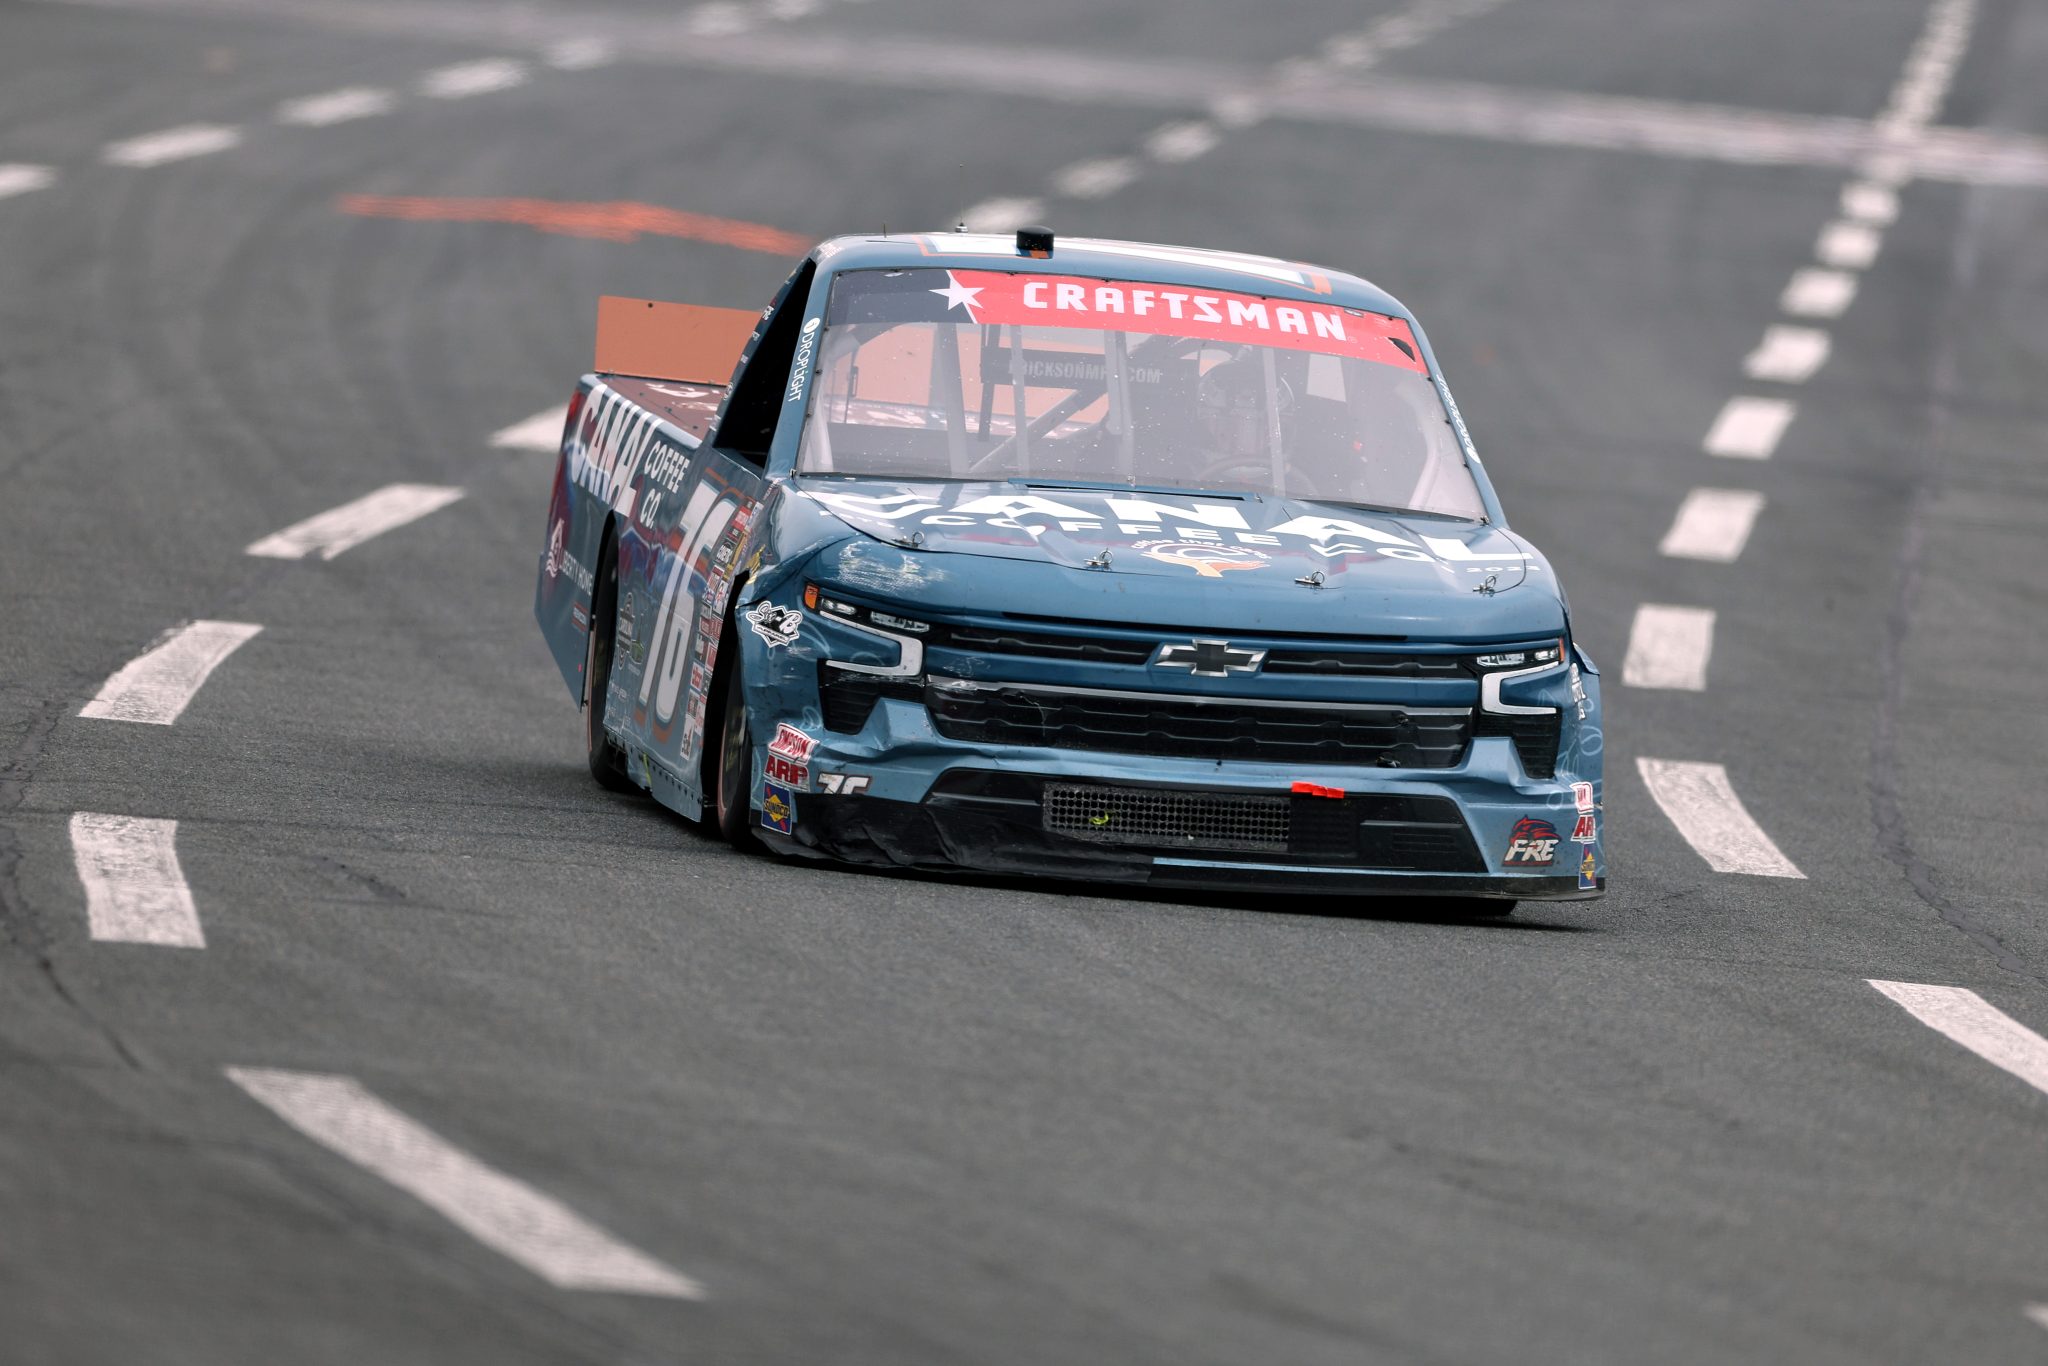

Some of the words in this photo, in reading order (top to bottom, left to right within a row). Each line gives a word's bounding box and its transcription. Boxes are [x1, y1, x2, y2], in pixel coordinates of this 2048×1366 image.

[1023, 282, 1347, 341] CRAFTSMAN
[572, 384, 664, 517] CANAL
[644, 441, 690, 494] COFFEE
[797, 490, 1533, 560] CANAL
[921, 515, 1282, 546] COFFEE
[638, 480, 736, 724] 76
[766, 754, 808, 786] ARP
[1505, 839, 1560, 862] FRE
